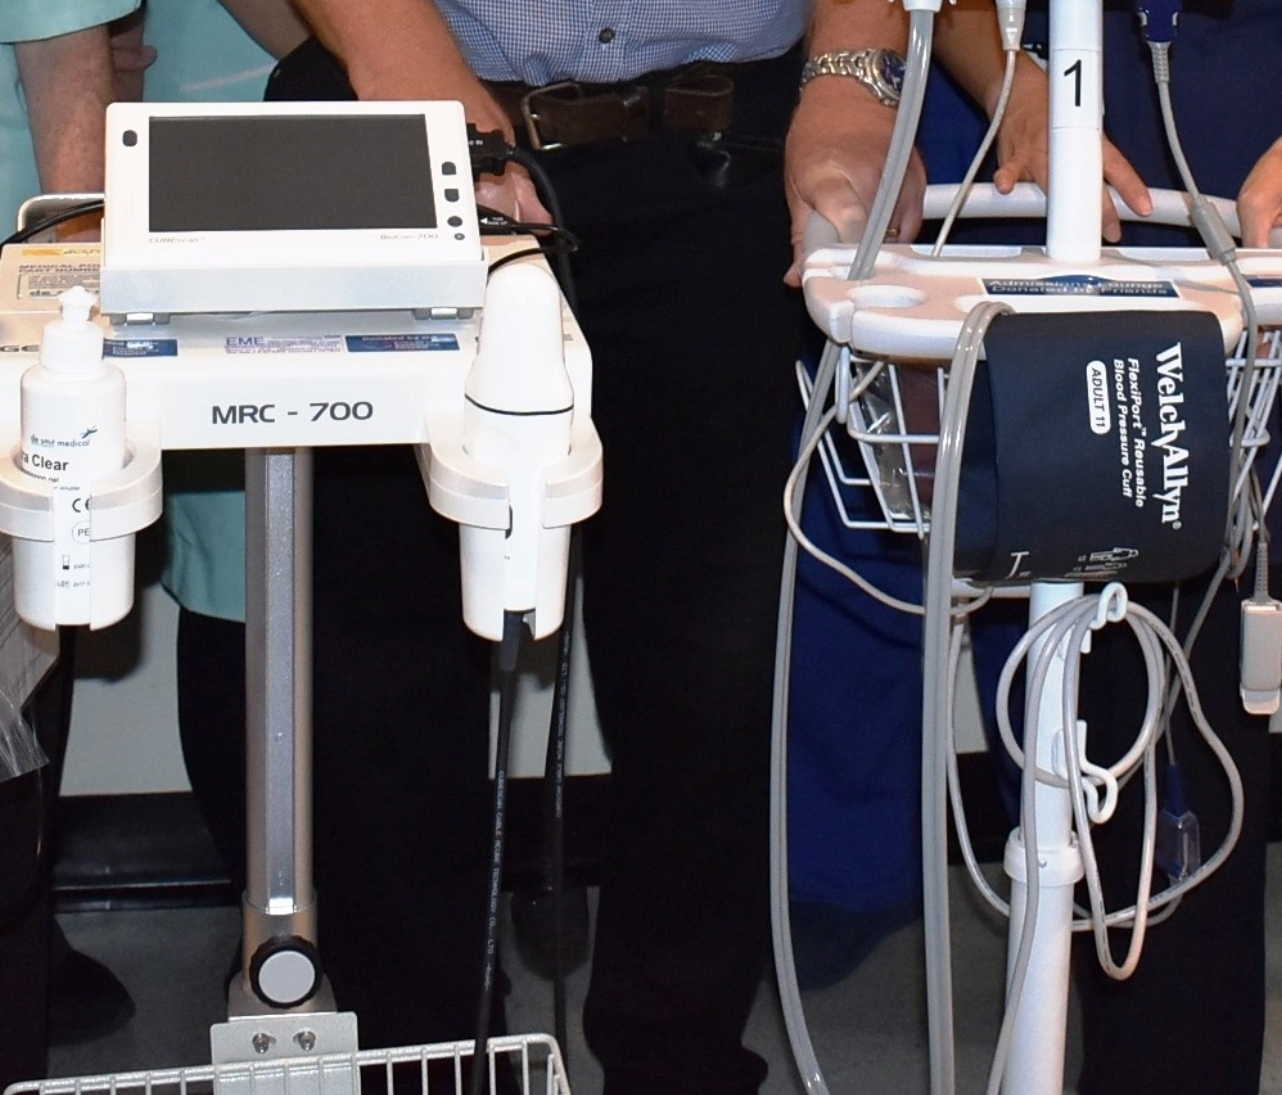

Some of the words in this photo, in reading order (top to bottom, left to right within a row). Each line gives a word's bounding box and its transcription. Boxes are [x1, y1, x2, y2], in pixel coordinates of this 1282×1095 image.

[1064, 59, 1082, 107] 1
[989, 280, 1090, 288] Admissions
[1099, 281, 1165, 289] Lounge
[992, 286, 1072, 294] Donated
[1092, 367, 1104, 411] ADULT
[1113, 359, 1126, 401] Blood
[212, 405, 275, 424] MRC
[309, 401, 373, 422] 700
[1095, 415, 1106, 430] 11
[57, 438, 90, 447] medical
[1118, 403, 1130, 466] Pressure
[31, 455, 69, 471] Clear
[1132, 439, 1146, 508] Reusable
[1122, 468, 1133, 498] Cuff
